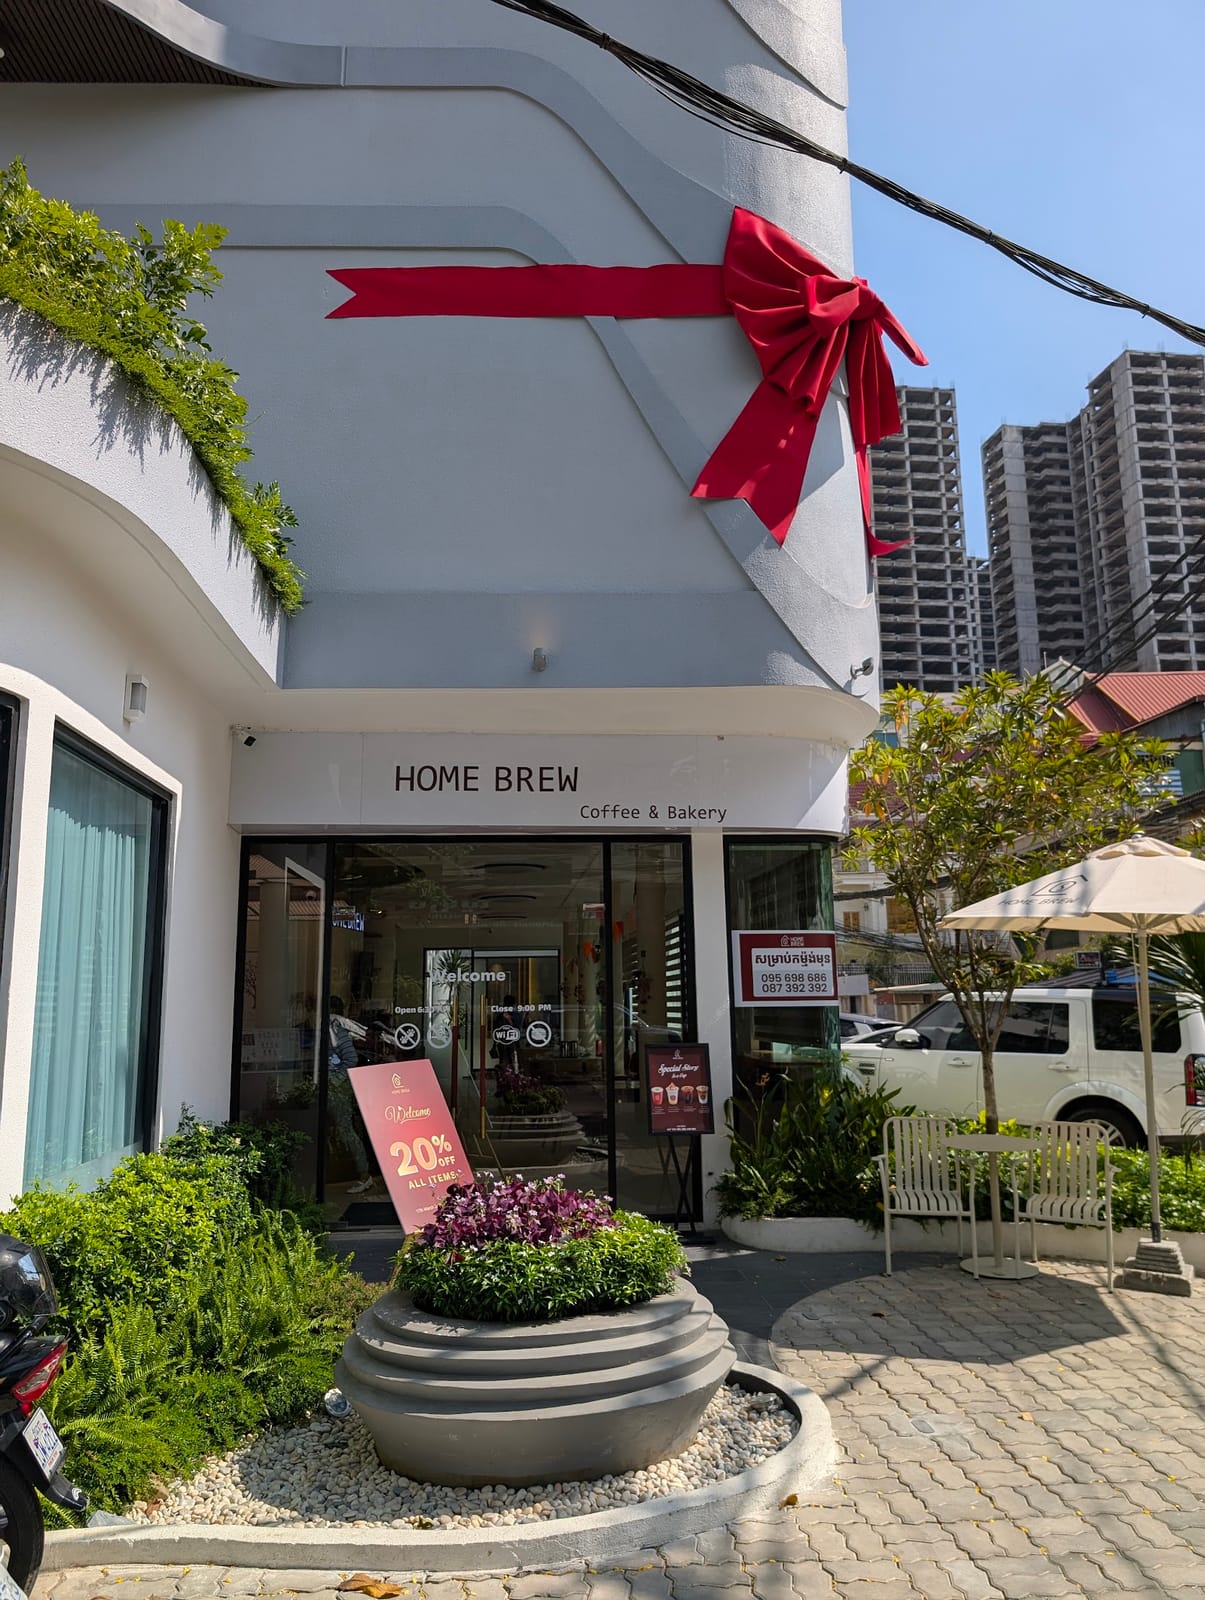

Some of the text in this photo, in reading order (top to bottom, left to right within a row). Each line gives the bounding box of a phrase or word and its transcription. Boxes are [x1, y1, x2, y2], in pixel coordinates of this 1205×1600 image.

[395, 765, 579, 792] HOME BREW
[580, 805, 727, 822] Coffee & Bakery
[428, 968, 506, 982] Welcome
[761, 973, 827, 982] 095 698 686
[762, 983, 827, 992] 087 392 392
[395, 1006, 416, 1014] Open
[517, 1004, 535, 1012] 9:00
[658, 1063, 699, 1077] Special Story
[385, 1105, 431, 1124] Welcome
[390, 1134, 456, 1177] 20% OFF
[408, 1170, 457, 1190] ALL ITEMS
